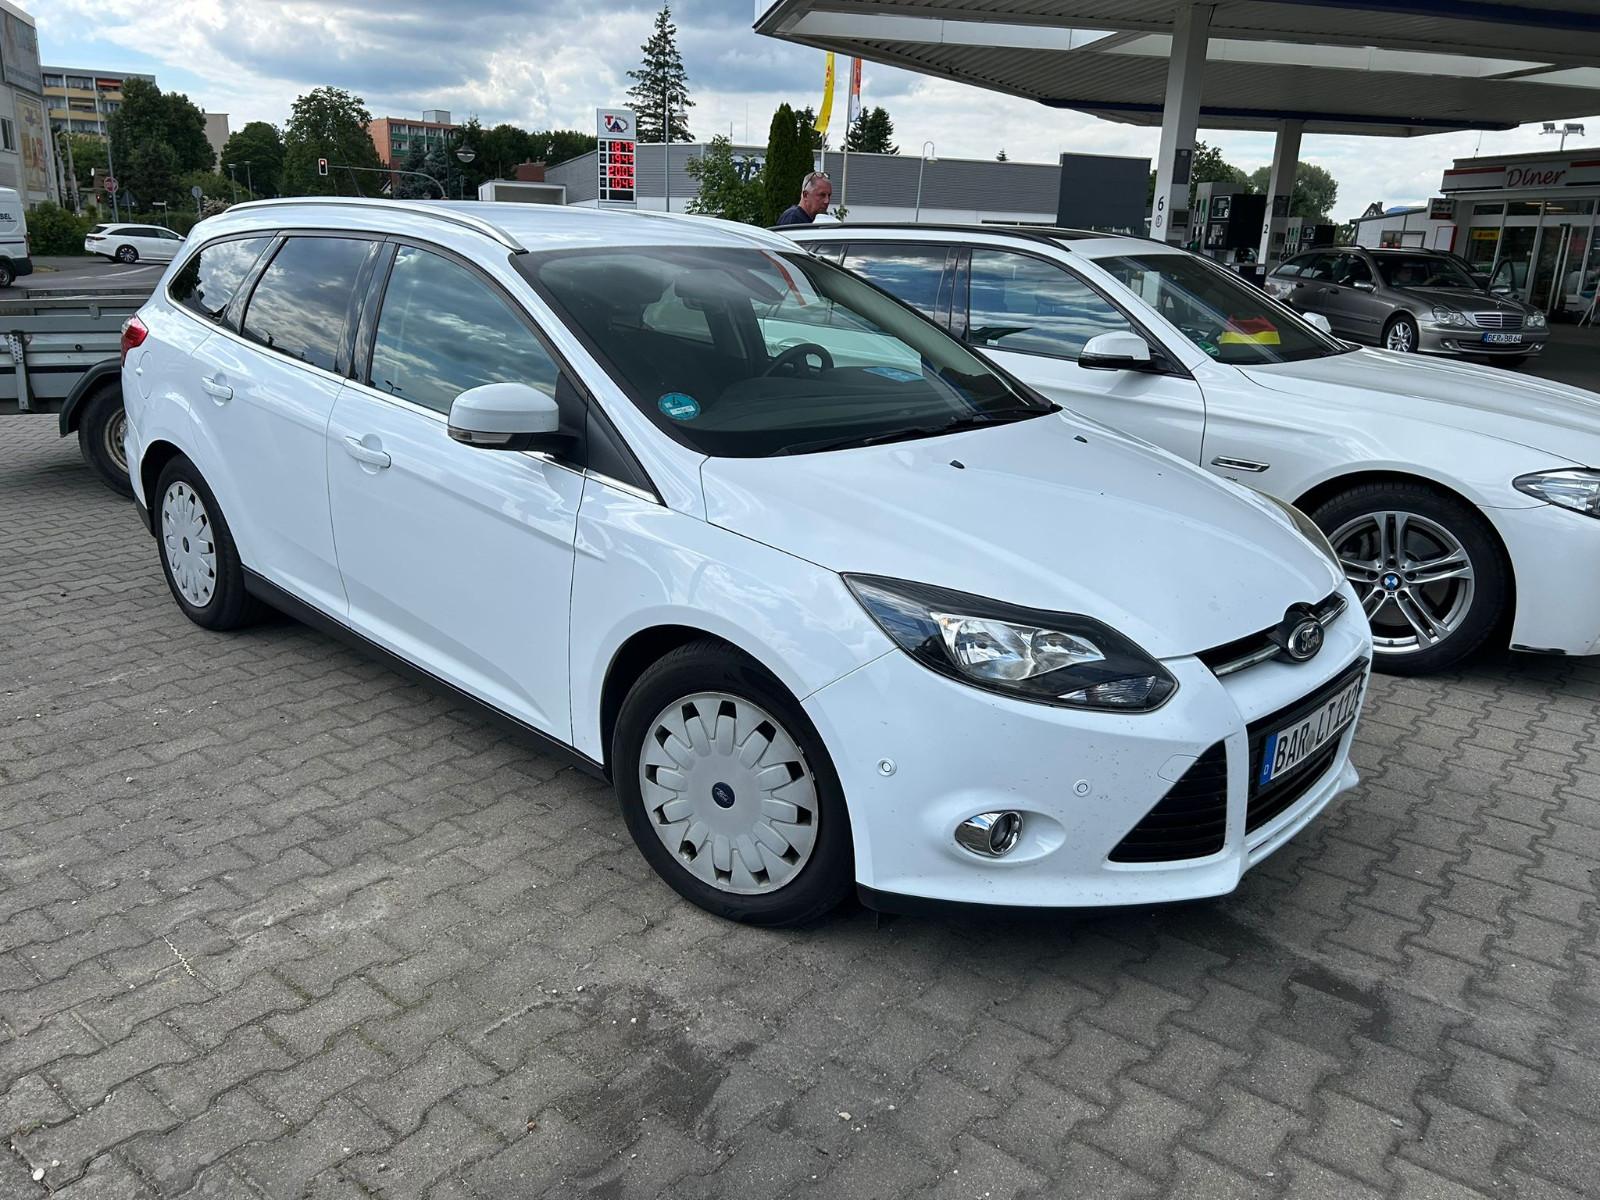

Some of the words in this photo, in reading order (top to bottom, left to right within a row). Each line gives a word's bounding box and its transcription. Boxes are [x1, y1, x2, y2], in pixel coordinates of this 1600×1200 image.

[1506, 168, 1566, 187] Diner
[1158, 196, 1164, 211] 6
[1263, 224, 1269, 234] 2
[1274, 722, 1310, 774] BAR
